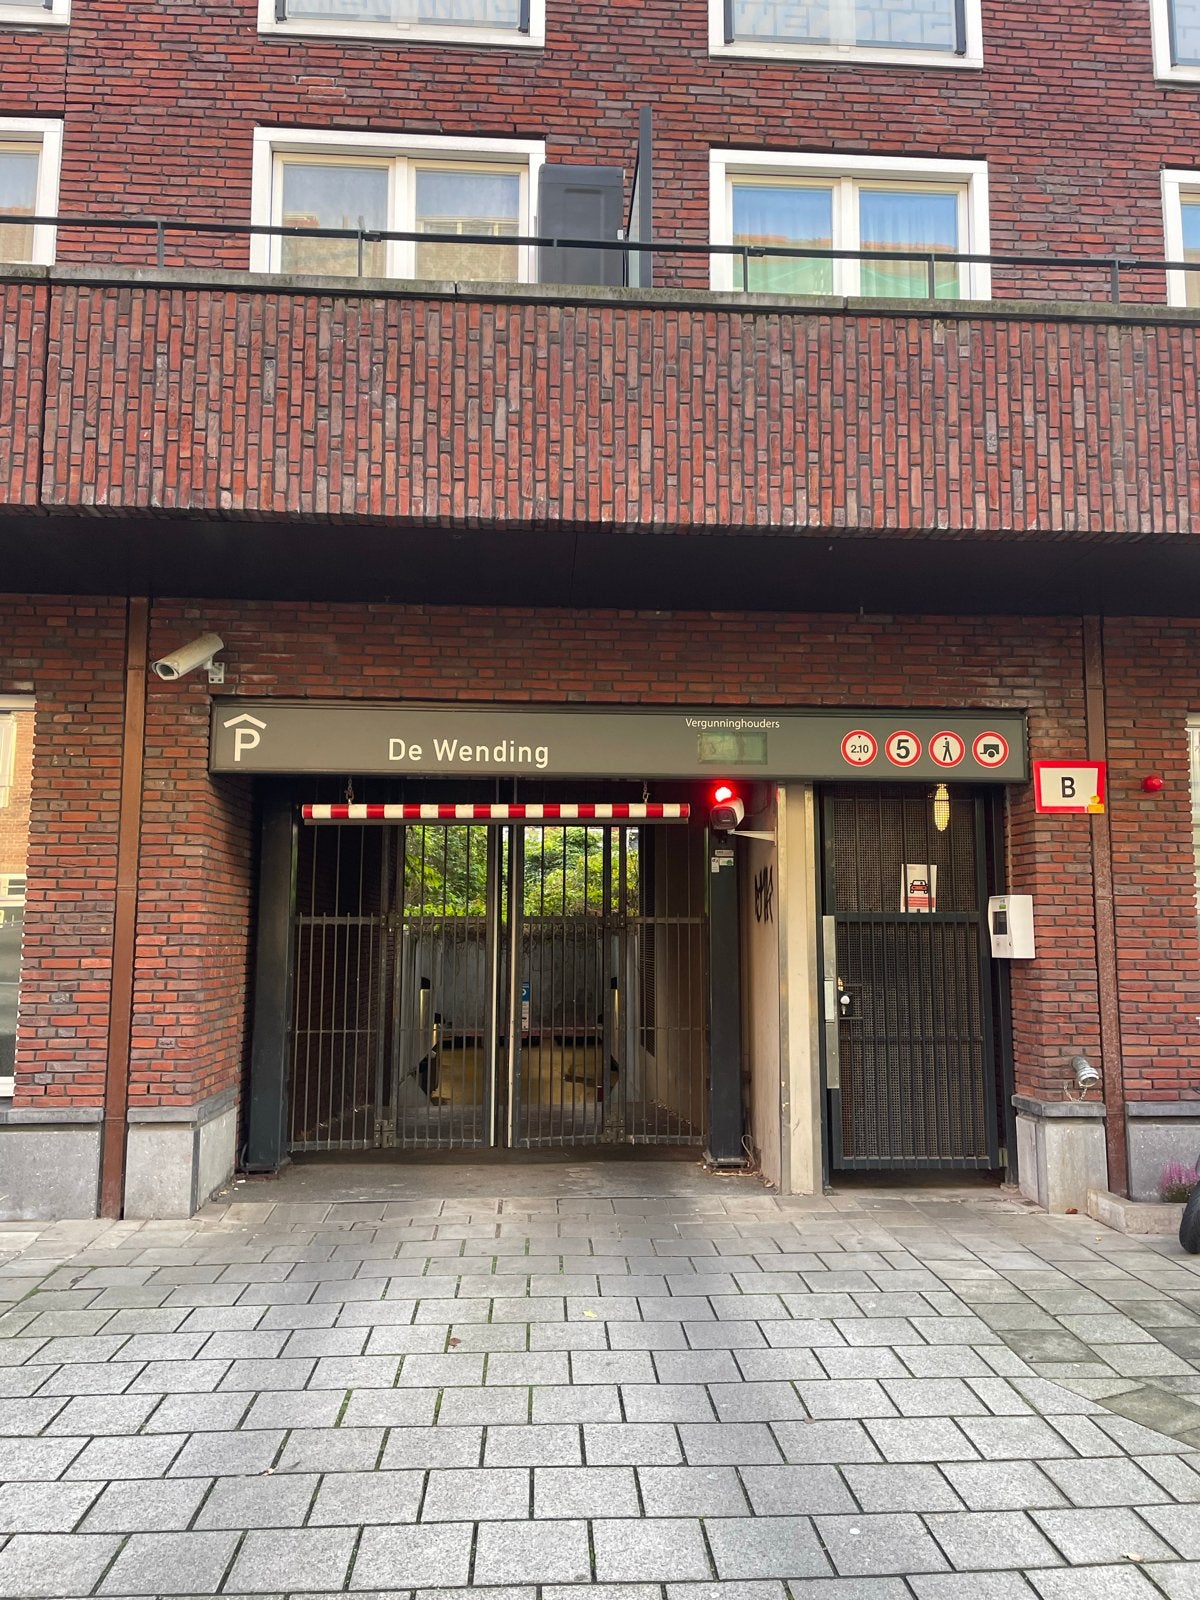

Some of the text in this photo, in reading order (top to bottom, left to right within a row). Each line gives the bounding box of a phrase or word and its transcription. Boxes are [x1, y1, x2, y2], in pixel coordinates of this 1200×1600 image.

[685, 718, 780, 730] Vergunninghouders
[234, 728, 261, 762] P
[388, 738, 549, 769] De Wending
[850, 744, 869, 754] 2.10
[896, 739, 910, 759] 5
[1061, 776, 1076, 798] B
